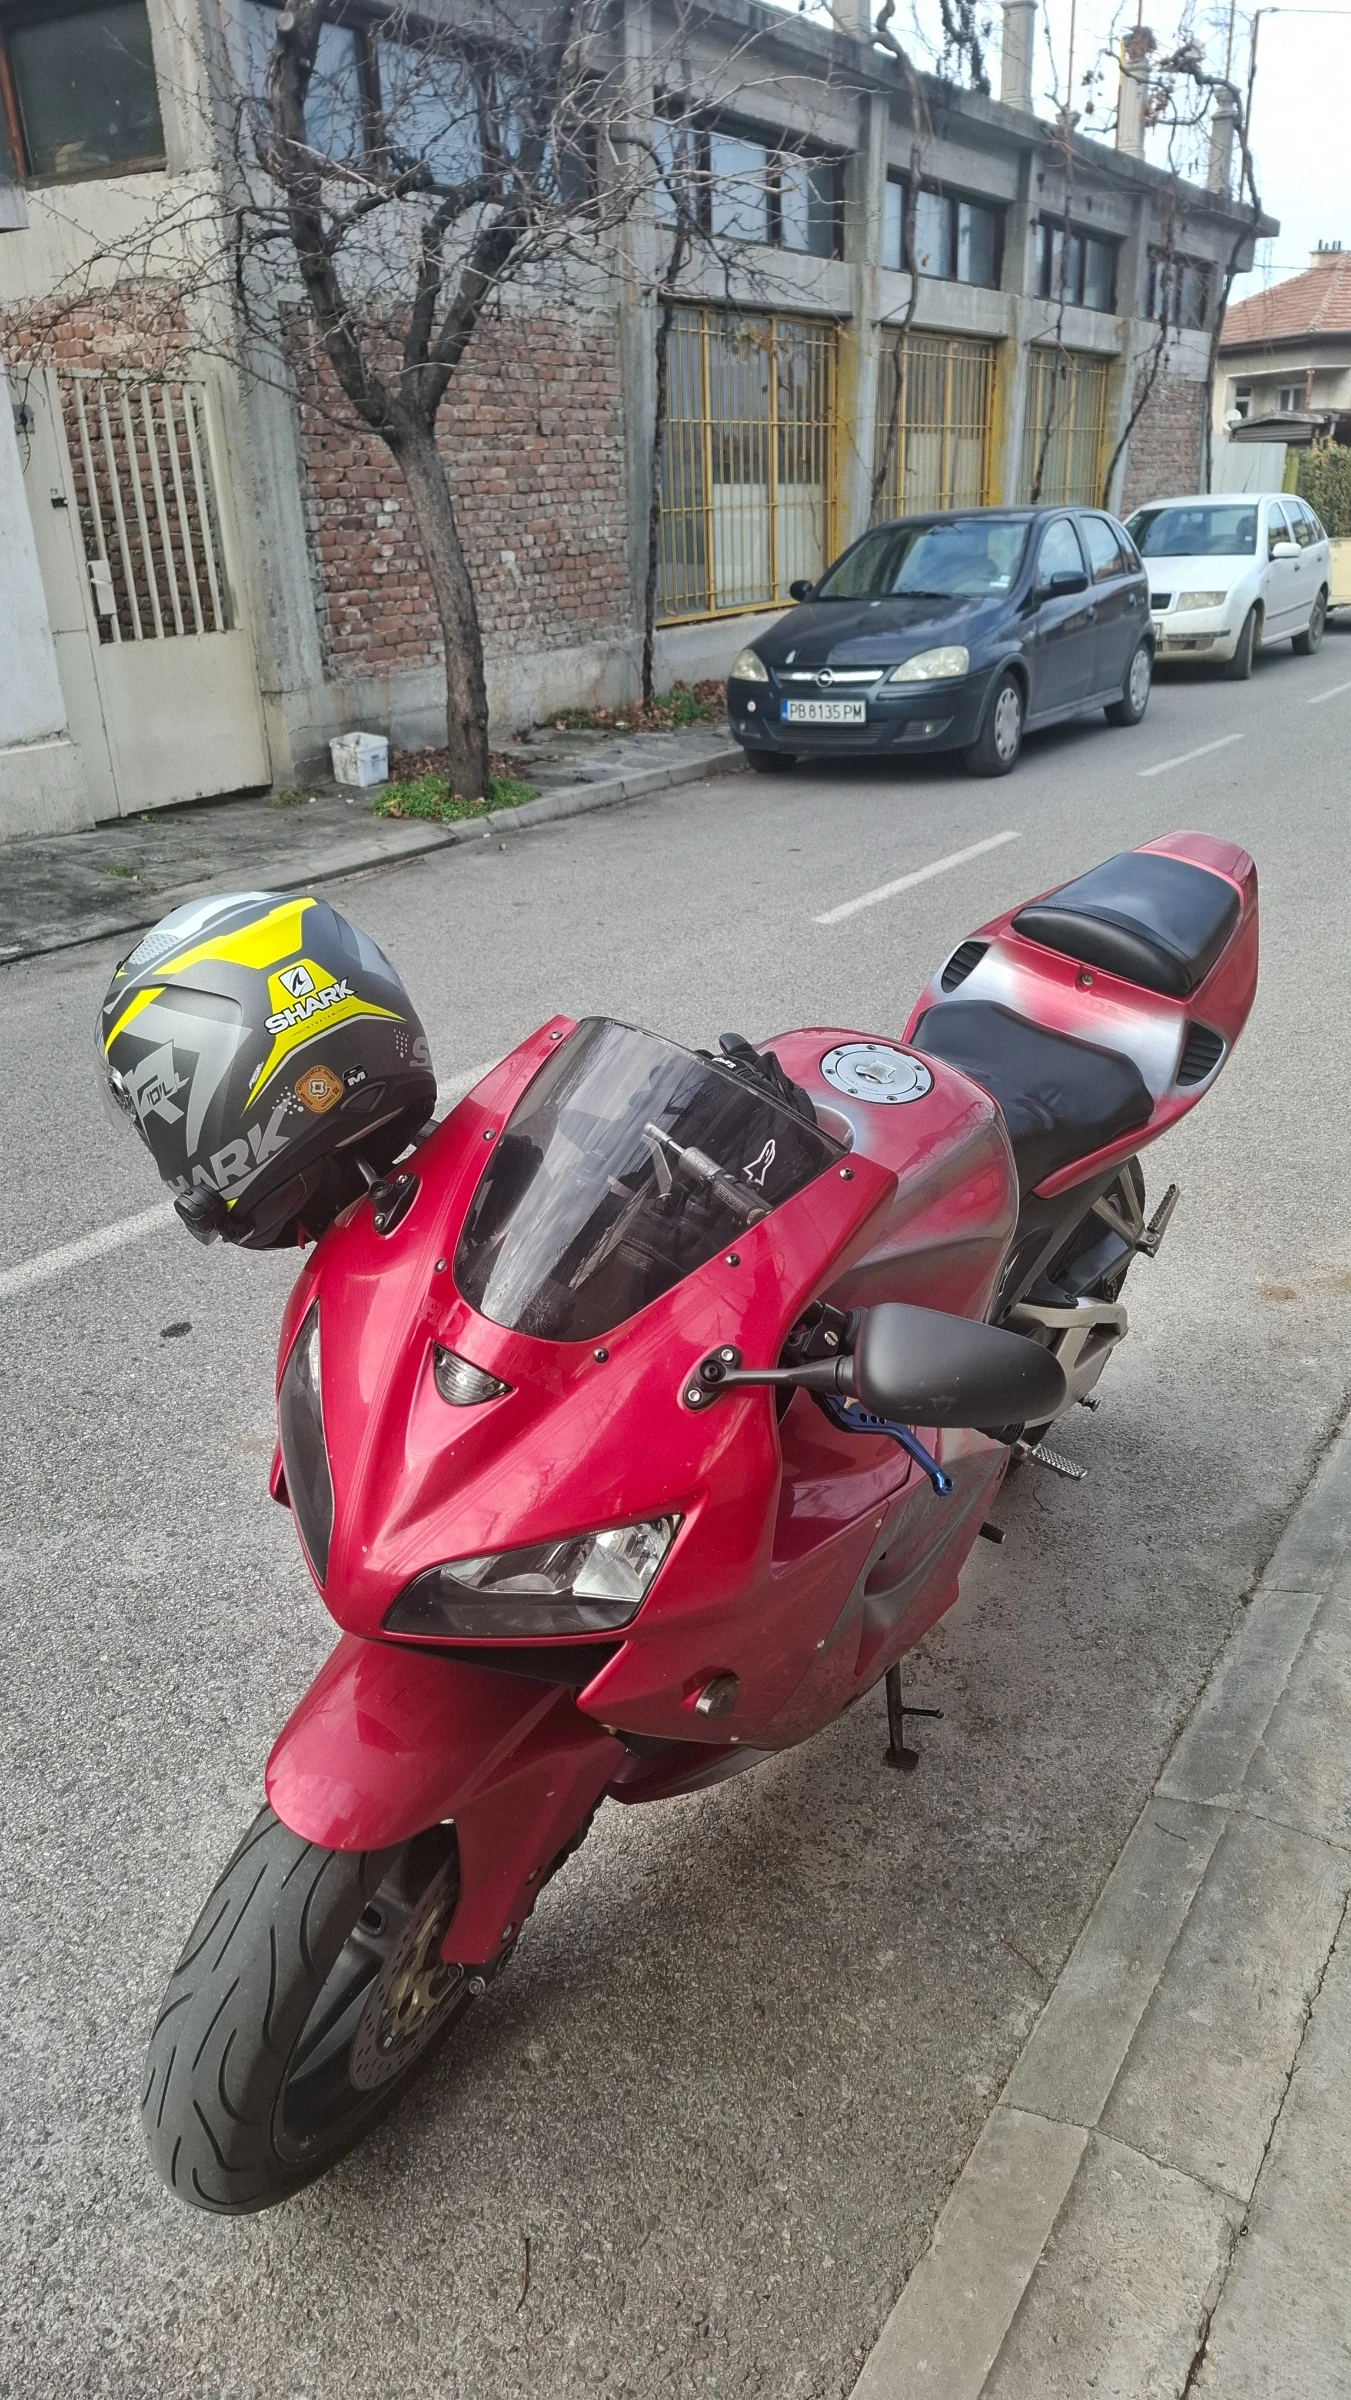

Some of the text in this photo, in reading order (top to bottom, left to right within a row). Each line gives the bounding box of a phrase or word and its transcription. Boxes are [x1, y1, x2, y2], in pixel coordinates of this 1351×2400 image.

[789, 703, 863, 720] PB 8135 PM
[264, 977, 356, 1035] SHARK
